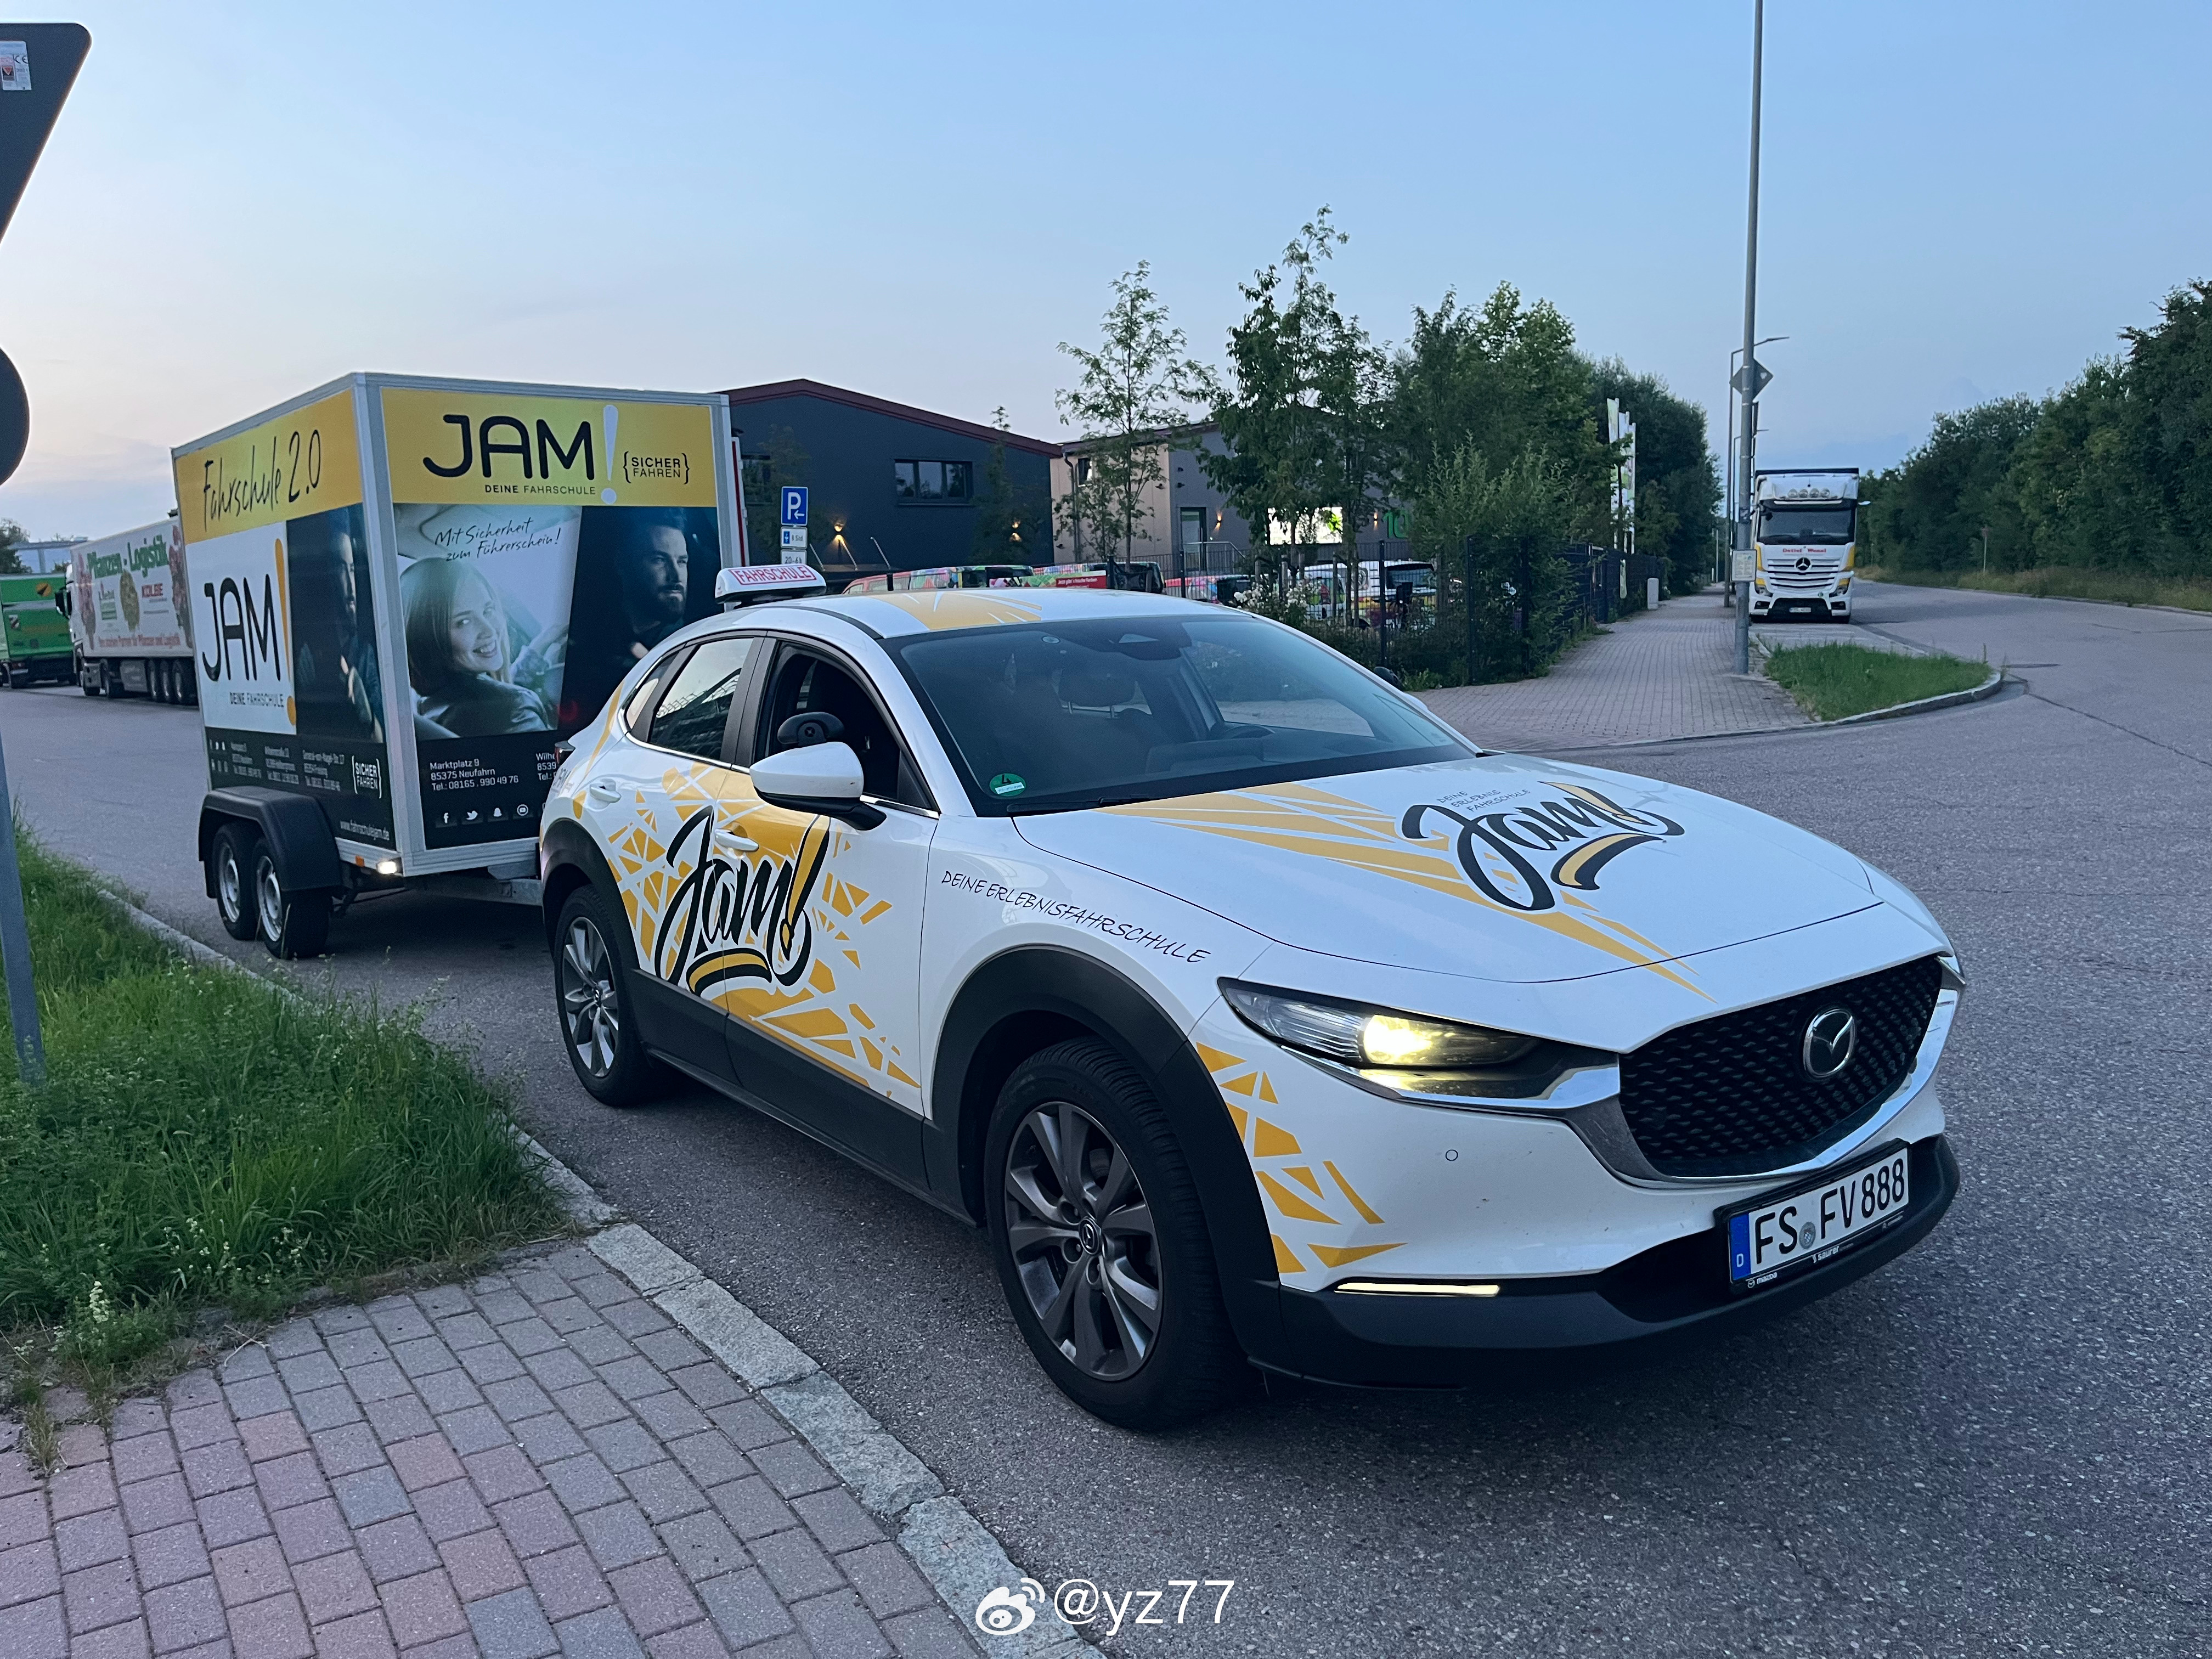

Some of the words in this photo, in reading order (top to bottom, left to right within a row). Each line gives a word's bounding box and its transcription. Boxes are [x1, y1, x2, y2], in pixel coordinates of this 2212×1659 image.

[204, 436, 281, 533] Fahrschule
[289, 430, 321, 503] 2.0
[485, 484, 519, 493] DEINE
[523, 485, 596, 495] FAHRSCHULE
[787, 492, 802, 520] P
[435, 527, 464, 546] Mit
[466, 517, 534, 544] Sicherheit
[445, 550, 471, 562] zum
[477, 527, 561, 558] Führerschein!
[735, 566, 812, 583] FAHRSCHULE
[430, 760, 473, 770] Marktplatz
[431, 770, 458, 781] 85375
[459, 768, 495, 778] Neufahrn
[448, 779, 475, 790] 08165
[479, 777, 496, 786] 990
[497, 776, 507, 785] 49
[508, 775, 519, 783] 76
[1436, 791, 1468, 803] DEINE
[1451, 789, 1501, 808] ERLEBNIS
[1466, 789, 1531, 812] FAHRSCHULE
[941, 871, 988, 894] DEINE
[986, 883, 1211, 963] ERLEBNISFAHRSCHULE
[1736, 1253, 1744, 1268] D
[1754, 1206, 1798, 1265] FS
